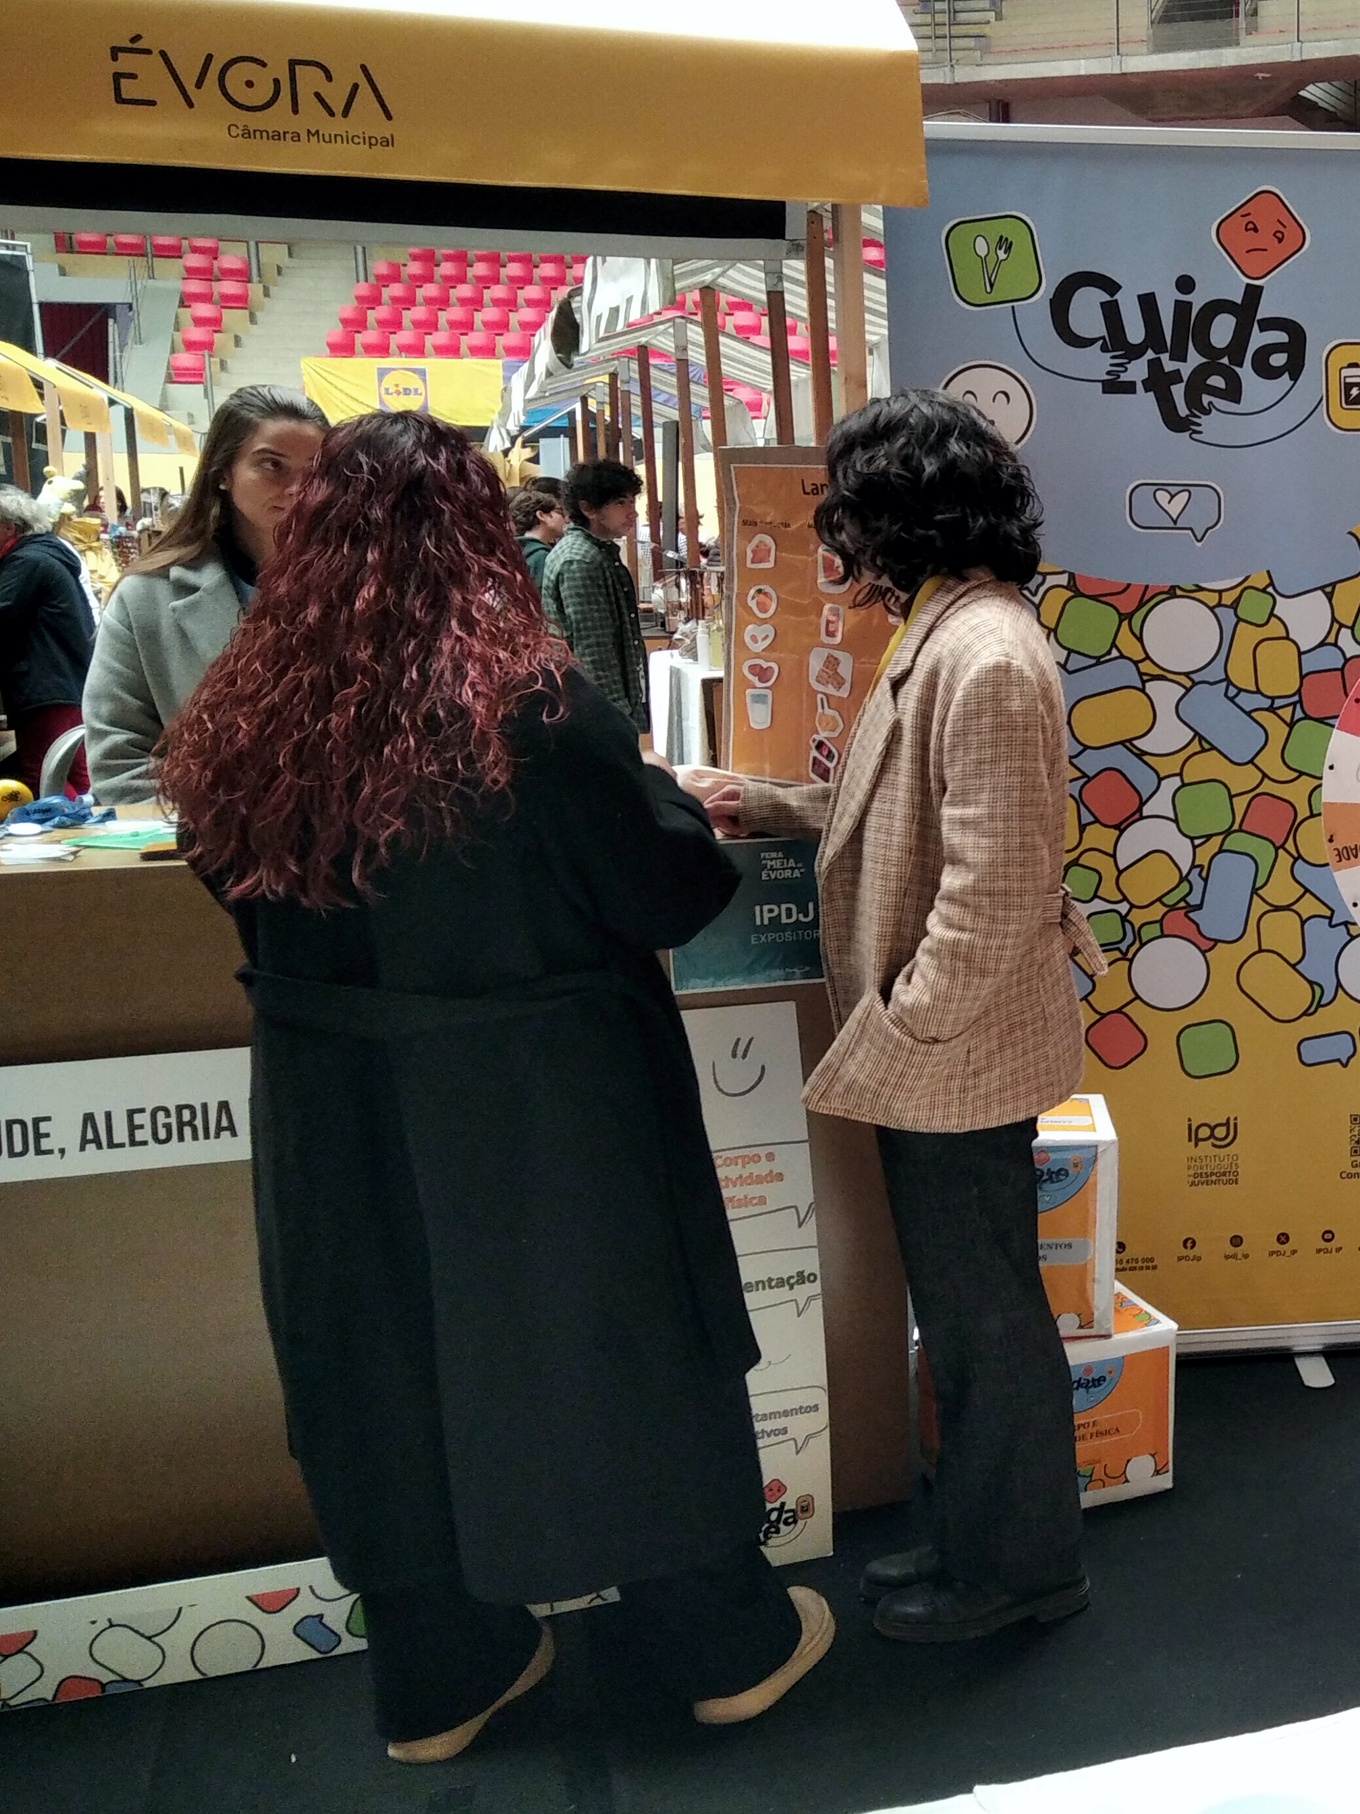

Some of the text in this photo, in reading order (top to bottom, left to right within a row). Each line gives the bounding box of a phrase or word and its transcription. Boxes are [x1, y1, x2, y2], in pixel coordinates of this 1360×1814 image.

[110, 34, 393, 121] ÉVORA
[227, 123, 395, 149] Câmara Municipal
[1050, 271, 1306, 380] Cuida
[754, 901, 814, 926] IPDJ
[0, 1100, 238, 1160] DE, ALEGRIA
[1187, 1116, 1238, 1149] ipdj
[714, 1151, 775, 1168] Corpo e
[1187, 1154, 1239, 1163] INSTITUTO
[1187, 1162, 1239, 1171] PORTUGUÊS
[720, 1170, 784, 1188] tividade
[1189, 1178, 1239, 1187] JUVENTUDE
[1193, 1170, 1239, 1179] DESPORTO
[743, 1270, 818, 1293] entação
[754, 1403, 819, 1422] tamentos
[756, 1426, 788, 1439] tivos
